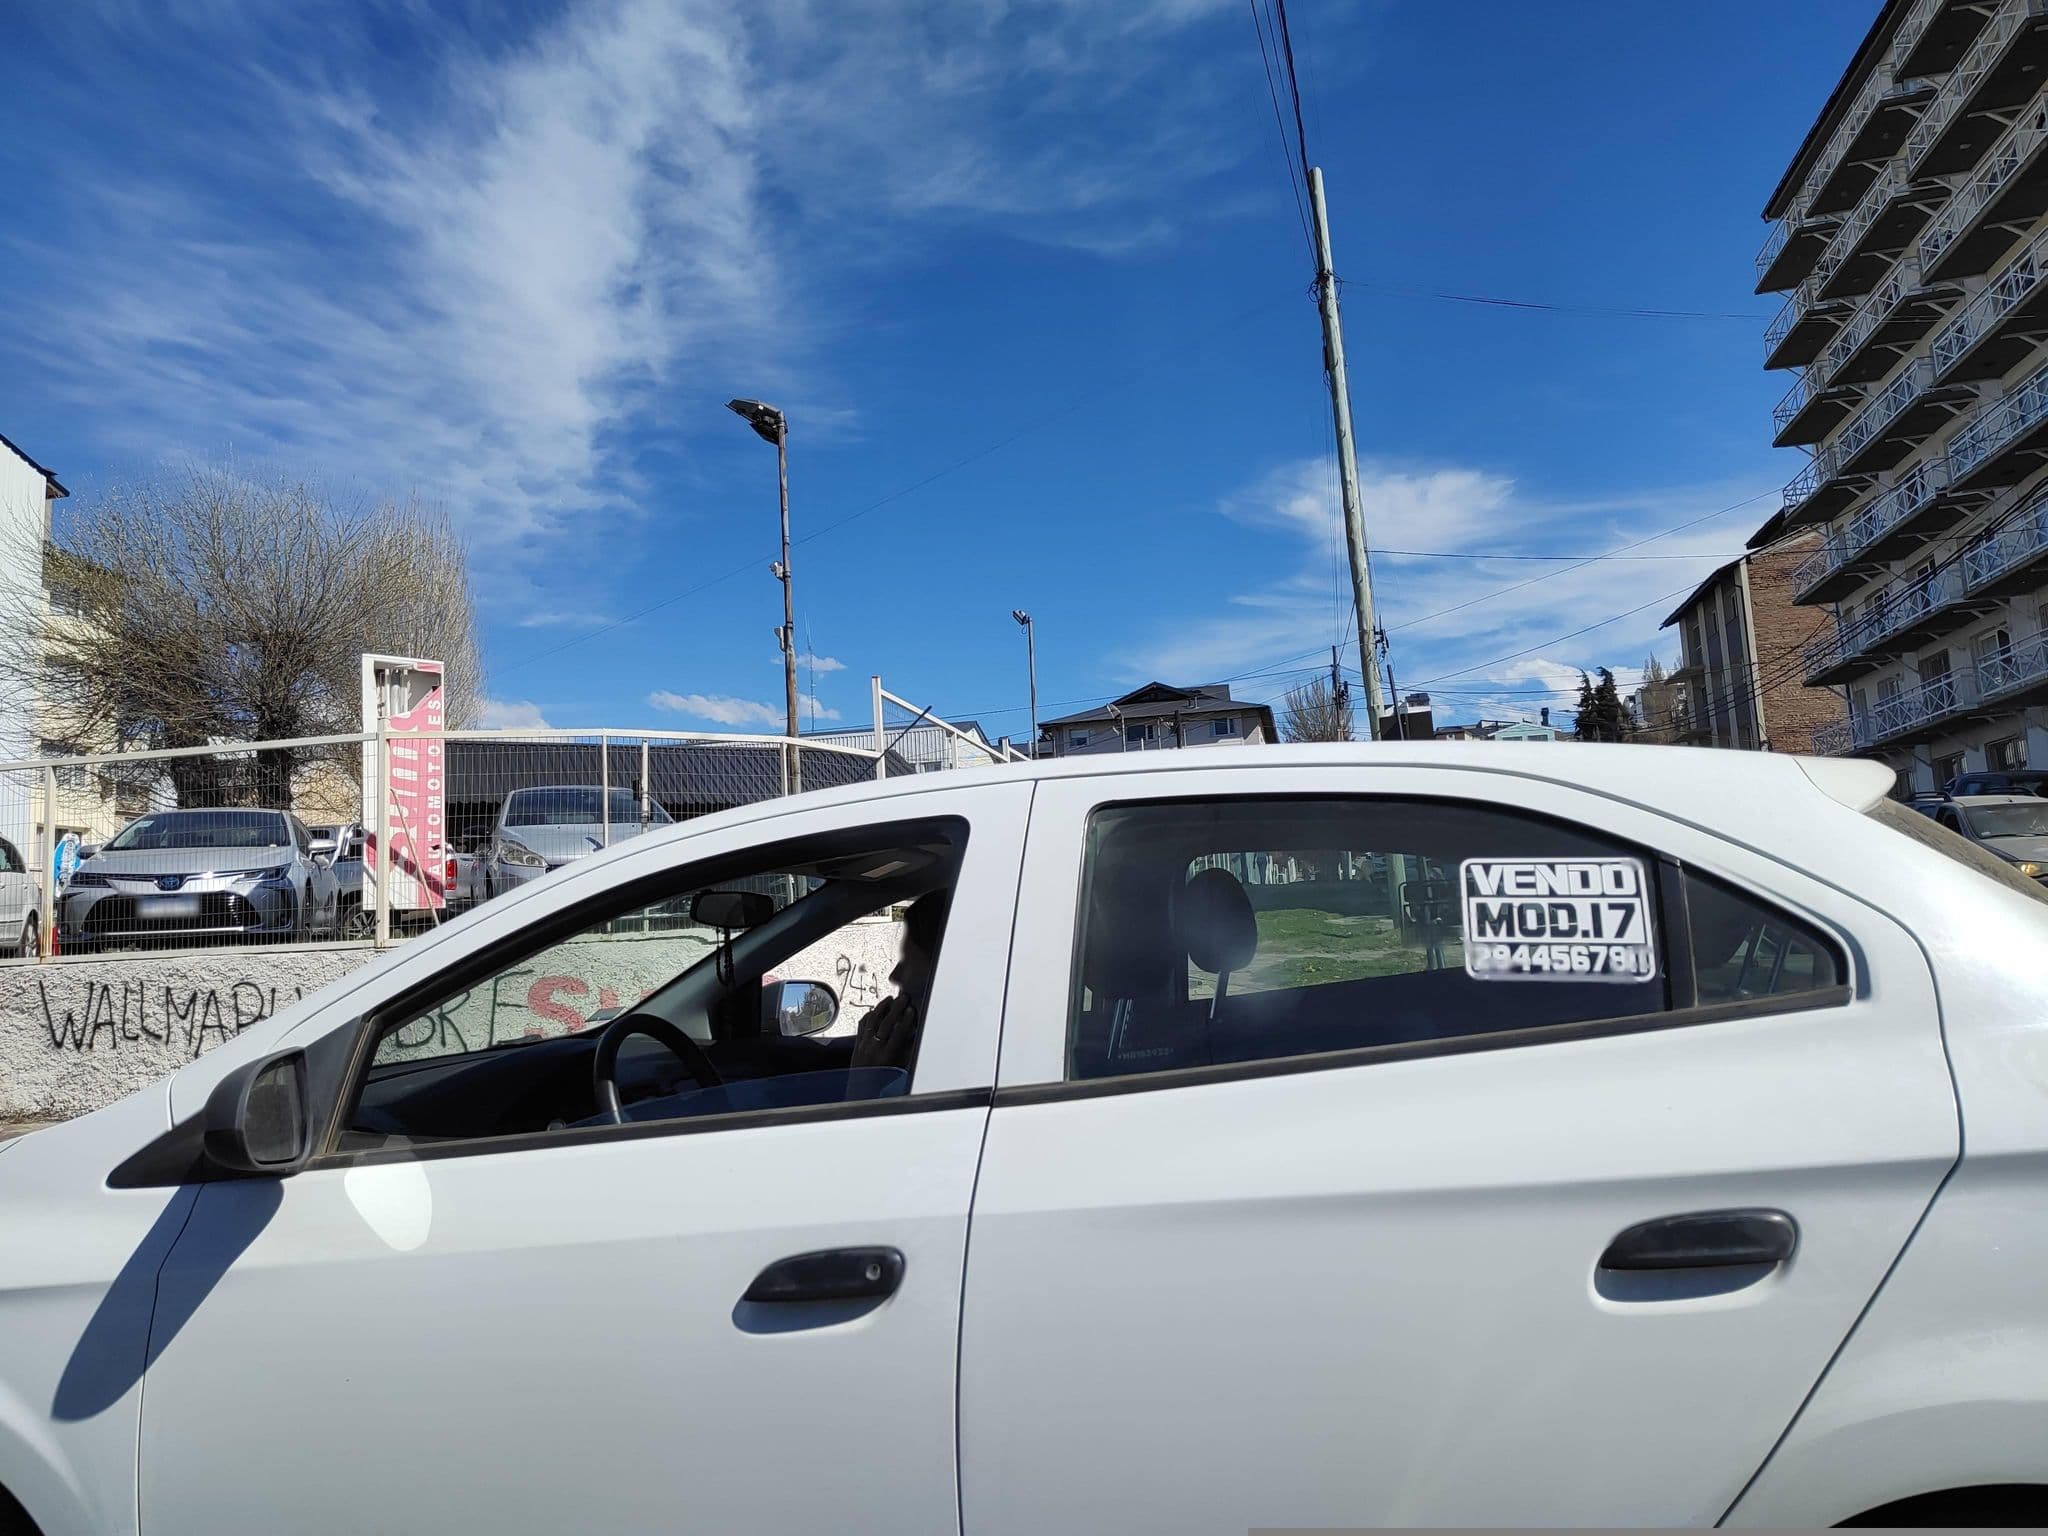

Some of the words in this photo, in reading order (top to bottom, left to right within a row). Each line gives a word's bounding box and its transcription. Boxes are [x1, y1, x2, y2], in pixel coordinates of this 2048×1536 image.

[427, 700, 441, 876] AUTOMOTOES
[1470, 864, 1637, 896] VENDO
[1475, 902, 1636, 939] MOD.17
